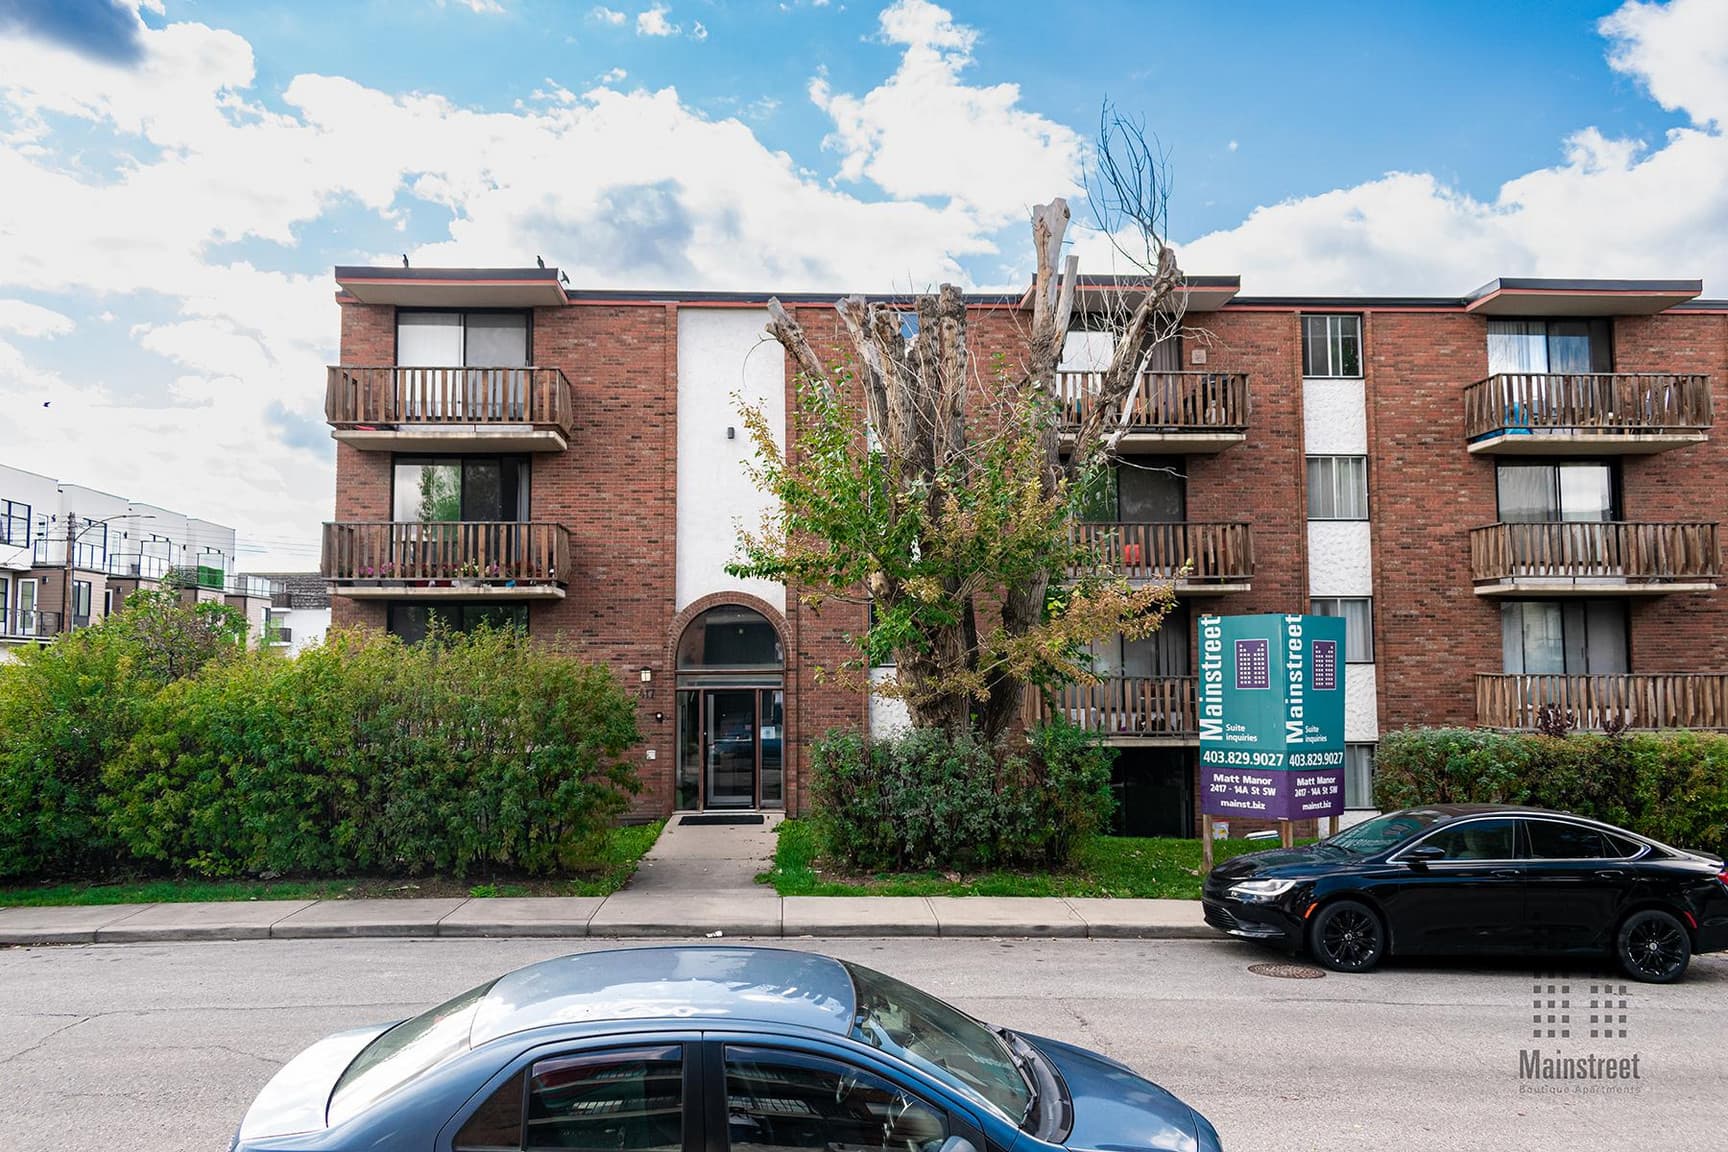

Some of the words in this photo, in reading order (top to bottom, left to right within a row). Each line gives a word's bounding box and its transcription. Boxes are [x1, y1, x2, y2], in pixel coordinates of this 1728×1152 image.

[1199, 615, 1223, 741] Mainstreet
[1285, 613, 1304, 744] Mainstreet
[1225, 723, 1246, 733] Suite
[1305, 725, 1320, 734] Suite
[1225, 734, 1258, 743] inquiries
[1305, 735, 1328, 744] inquiries
[1203, 750, 1285, 767] 403.829.9027
[1289, 752, 1344, 767] 403.829.9027
[1213, 774, 1240, 784] Matt
[1242, 775, 1273, 786] Manor
[1296, 777, 1315, 787] Matt
[1316, 776, 1336, 785] Manor
[1210, 784, 1227, 793] 2417
[1251, 787, 1260, 796] St
[1262, 788, 1277, 797] SW
[1329, 785, 1338, 795] SW
[1220, 800, 1266, 810] mainst.biz
[1302, 801, 1332, 811] mainst.biz
